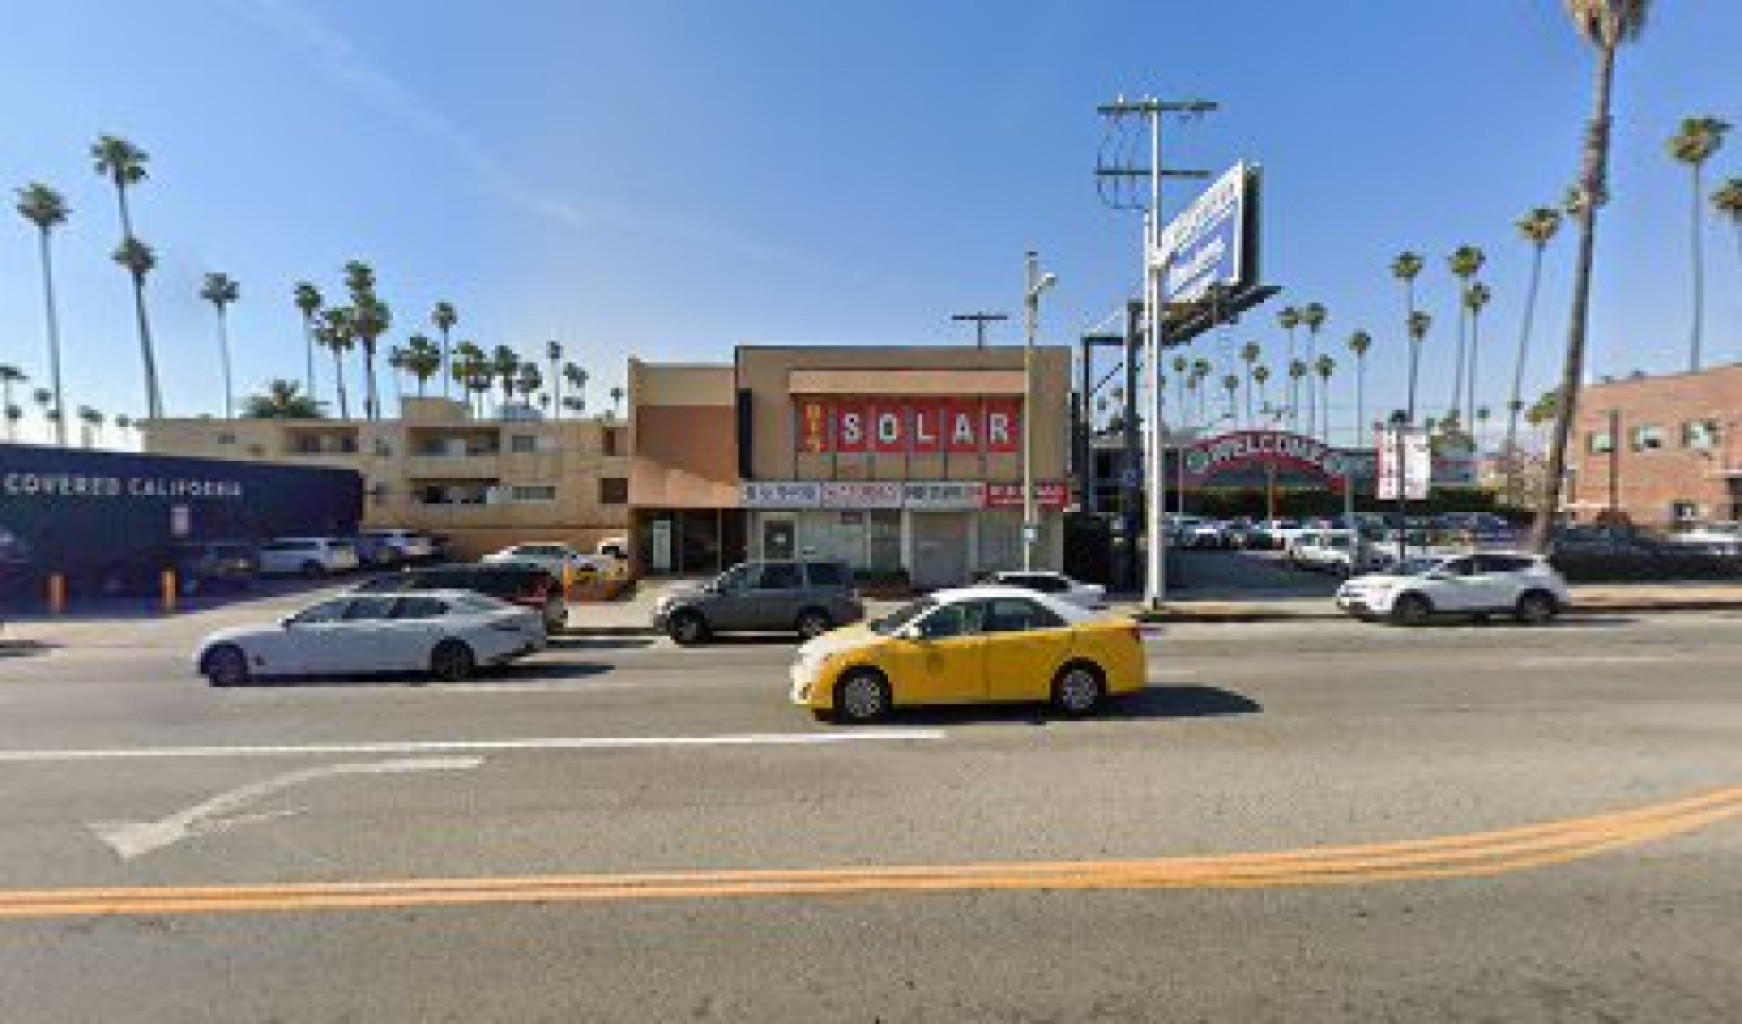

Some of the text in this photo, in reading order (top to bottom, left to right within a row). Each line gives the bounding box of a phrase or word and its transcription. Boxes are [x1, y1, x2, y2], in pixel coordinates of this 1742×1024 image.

[844, 412, 1008, 445] SOLAR
[4, 472, 243, 497] COVERED CALIFORNIA
